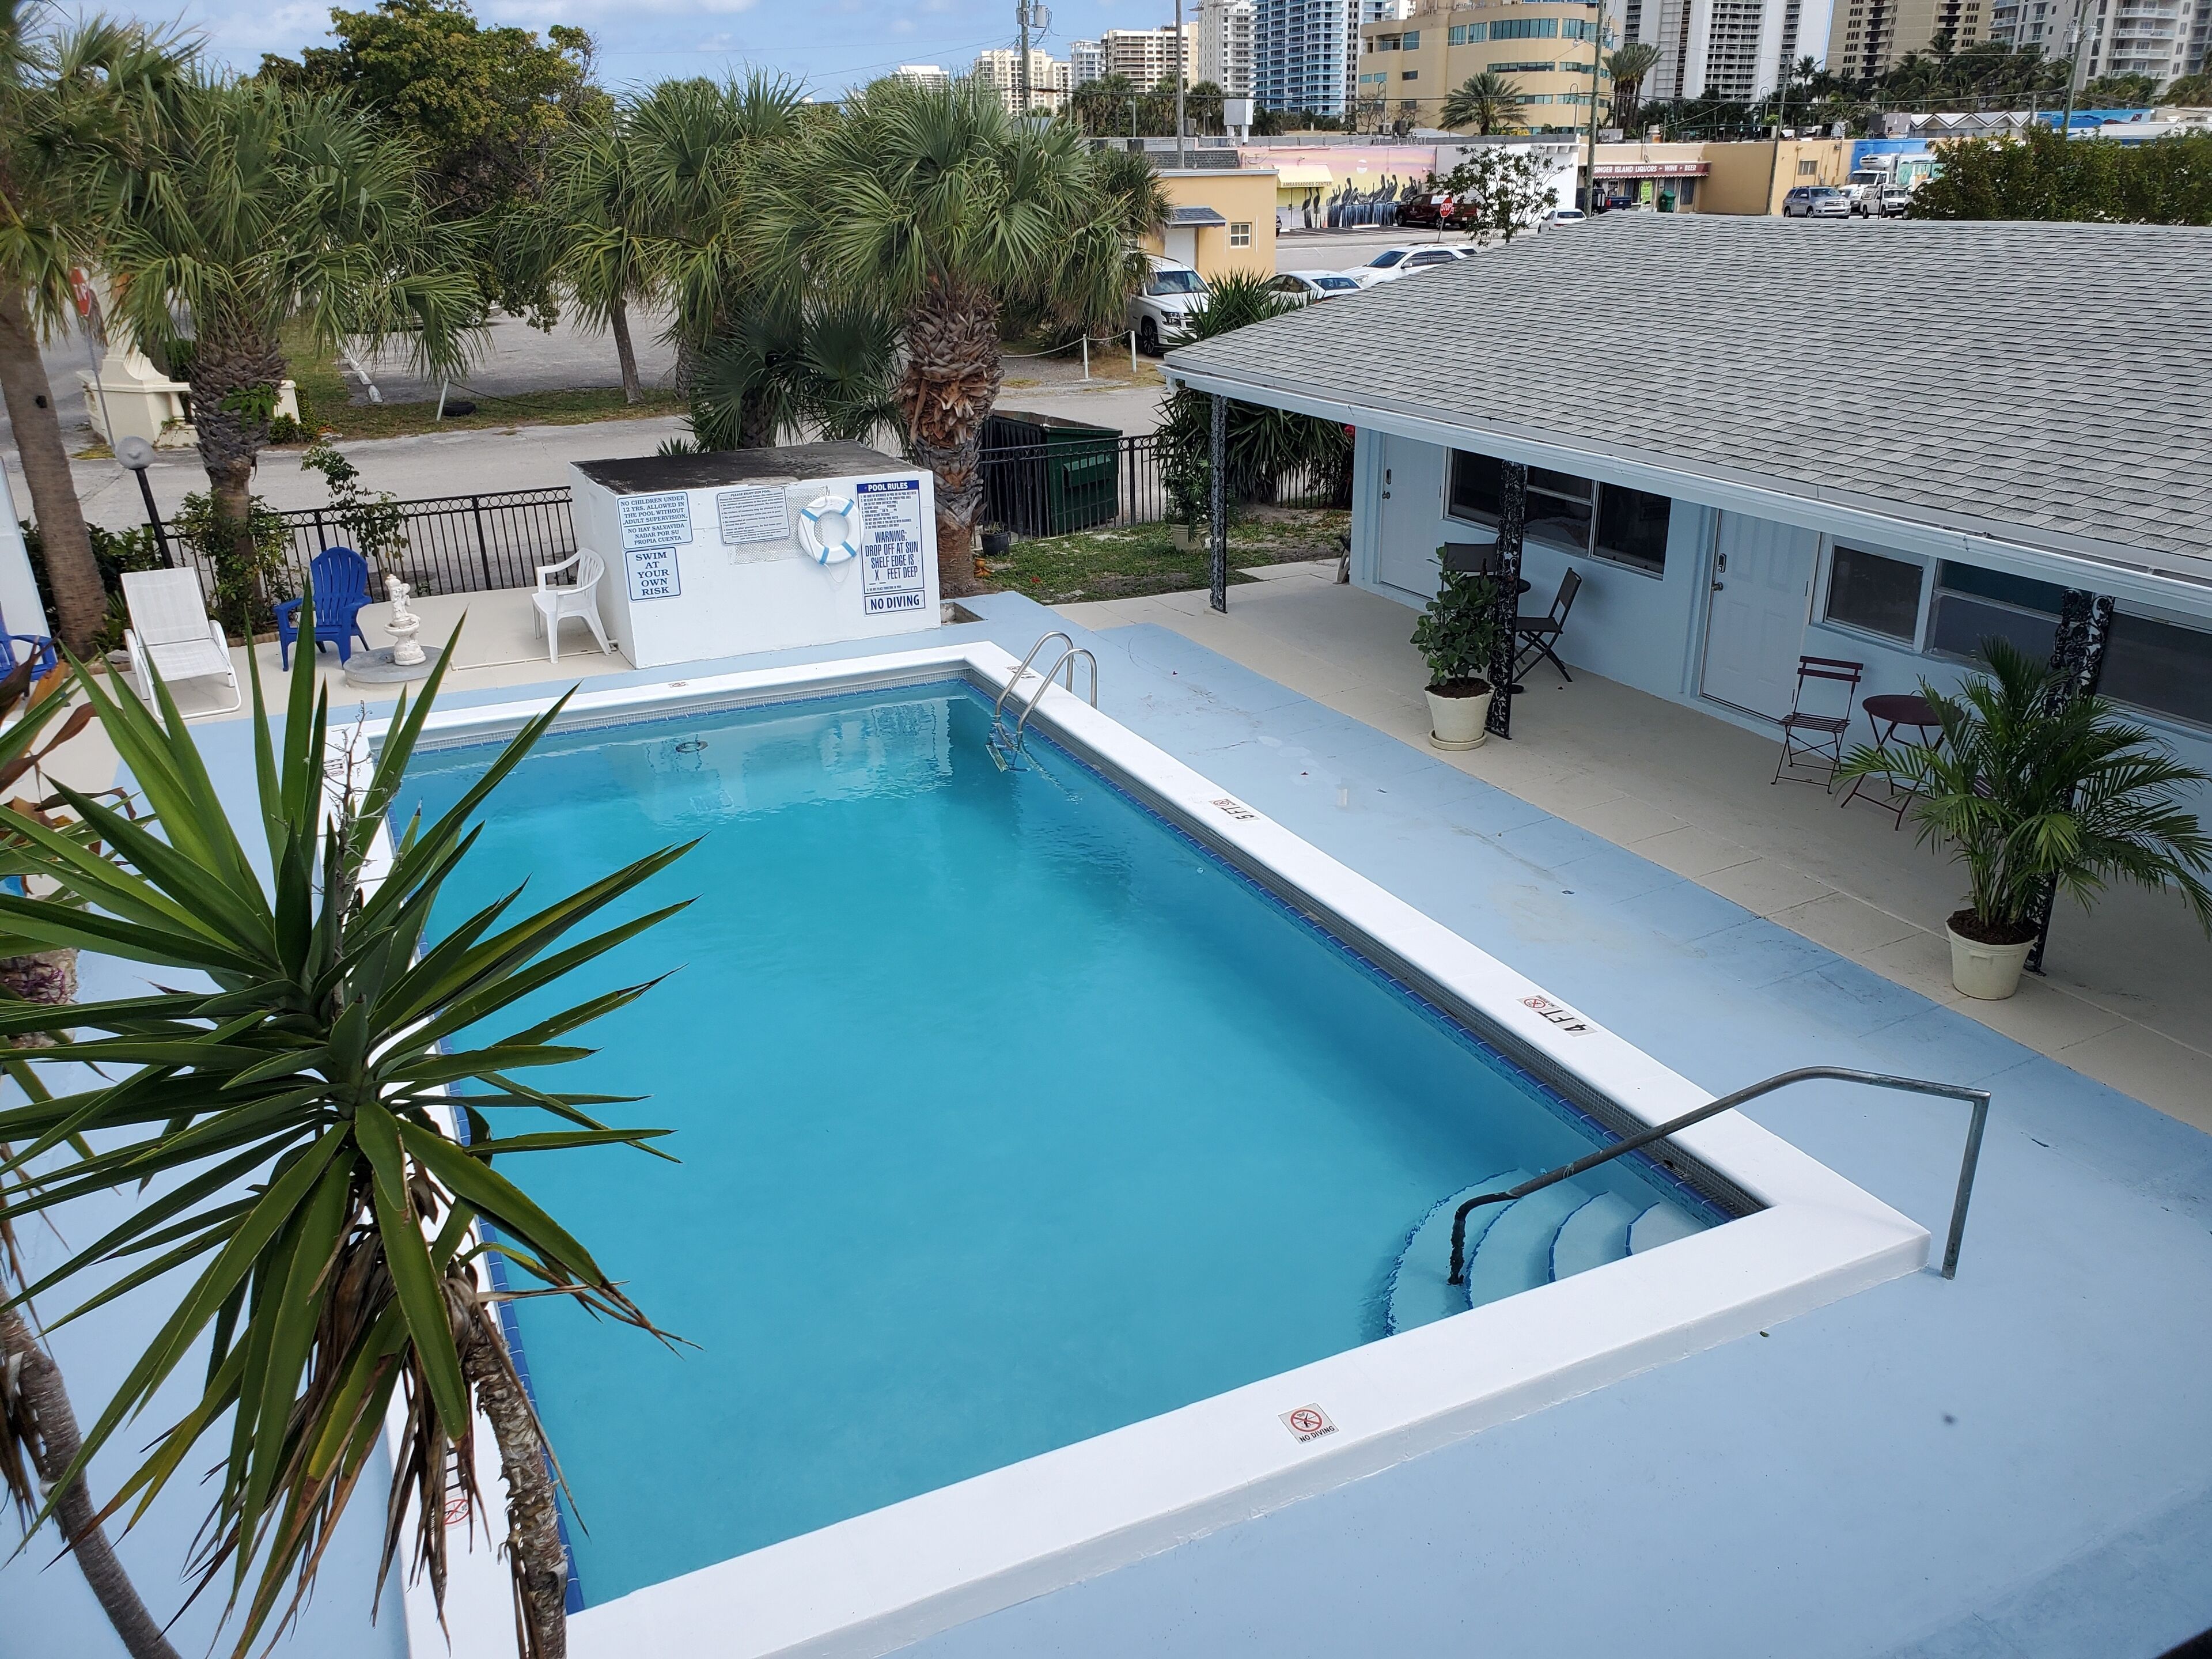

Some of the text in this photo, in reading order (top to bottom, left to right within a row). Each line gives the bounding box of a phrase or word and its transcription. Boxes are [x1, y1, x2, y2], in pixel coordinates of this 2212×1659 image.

[1441, 203, 1452, 211] STOP
[868, 482, 908, 492] POOL RULES
[631, 498, 662, 506] CHILDREN
[875, 529, 907, 543] WARNING:
[865, 541, 919, 557] DROP OFF AT SUN
[635, 551, 668, 561] SWIM
[645, 561, 660, 569] AT
[871, 554, 914, 569] SHELF EDGE IS
[637, 569, 670, 578] YOUR
[887, 567, 901, 579] FEET
[903, 566, 918, 578] DEEP
[641, 578, 668, 587] OWN
[641, 586, 669, 596] RISK
[870, 594, 919, 610] NO DIVING
[1221, 806, 1247, 815] FT
[1538, 1010, 1575, 1023] FT
[1299, 1426, 1335, 1442] NO DIVING
